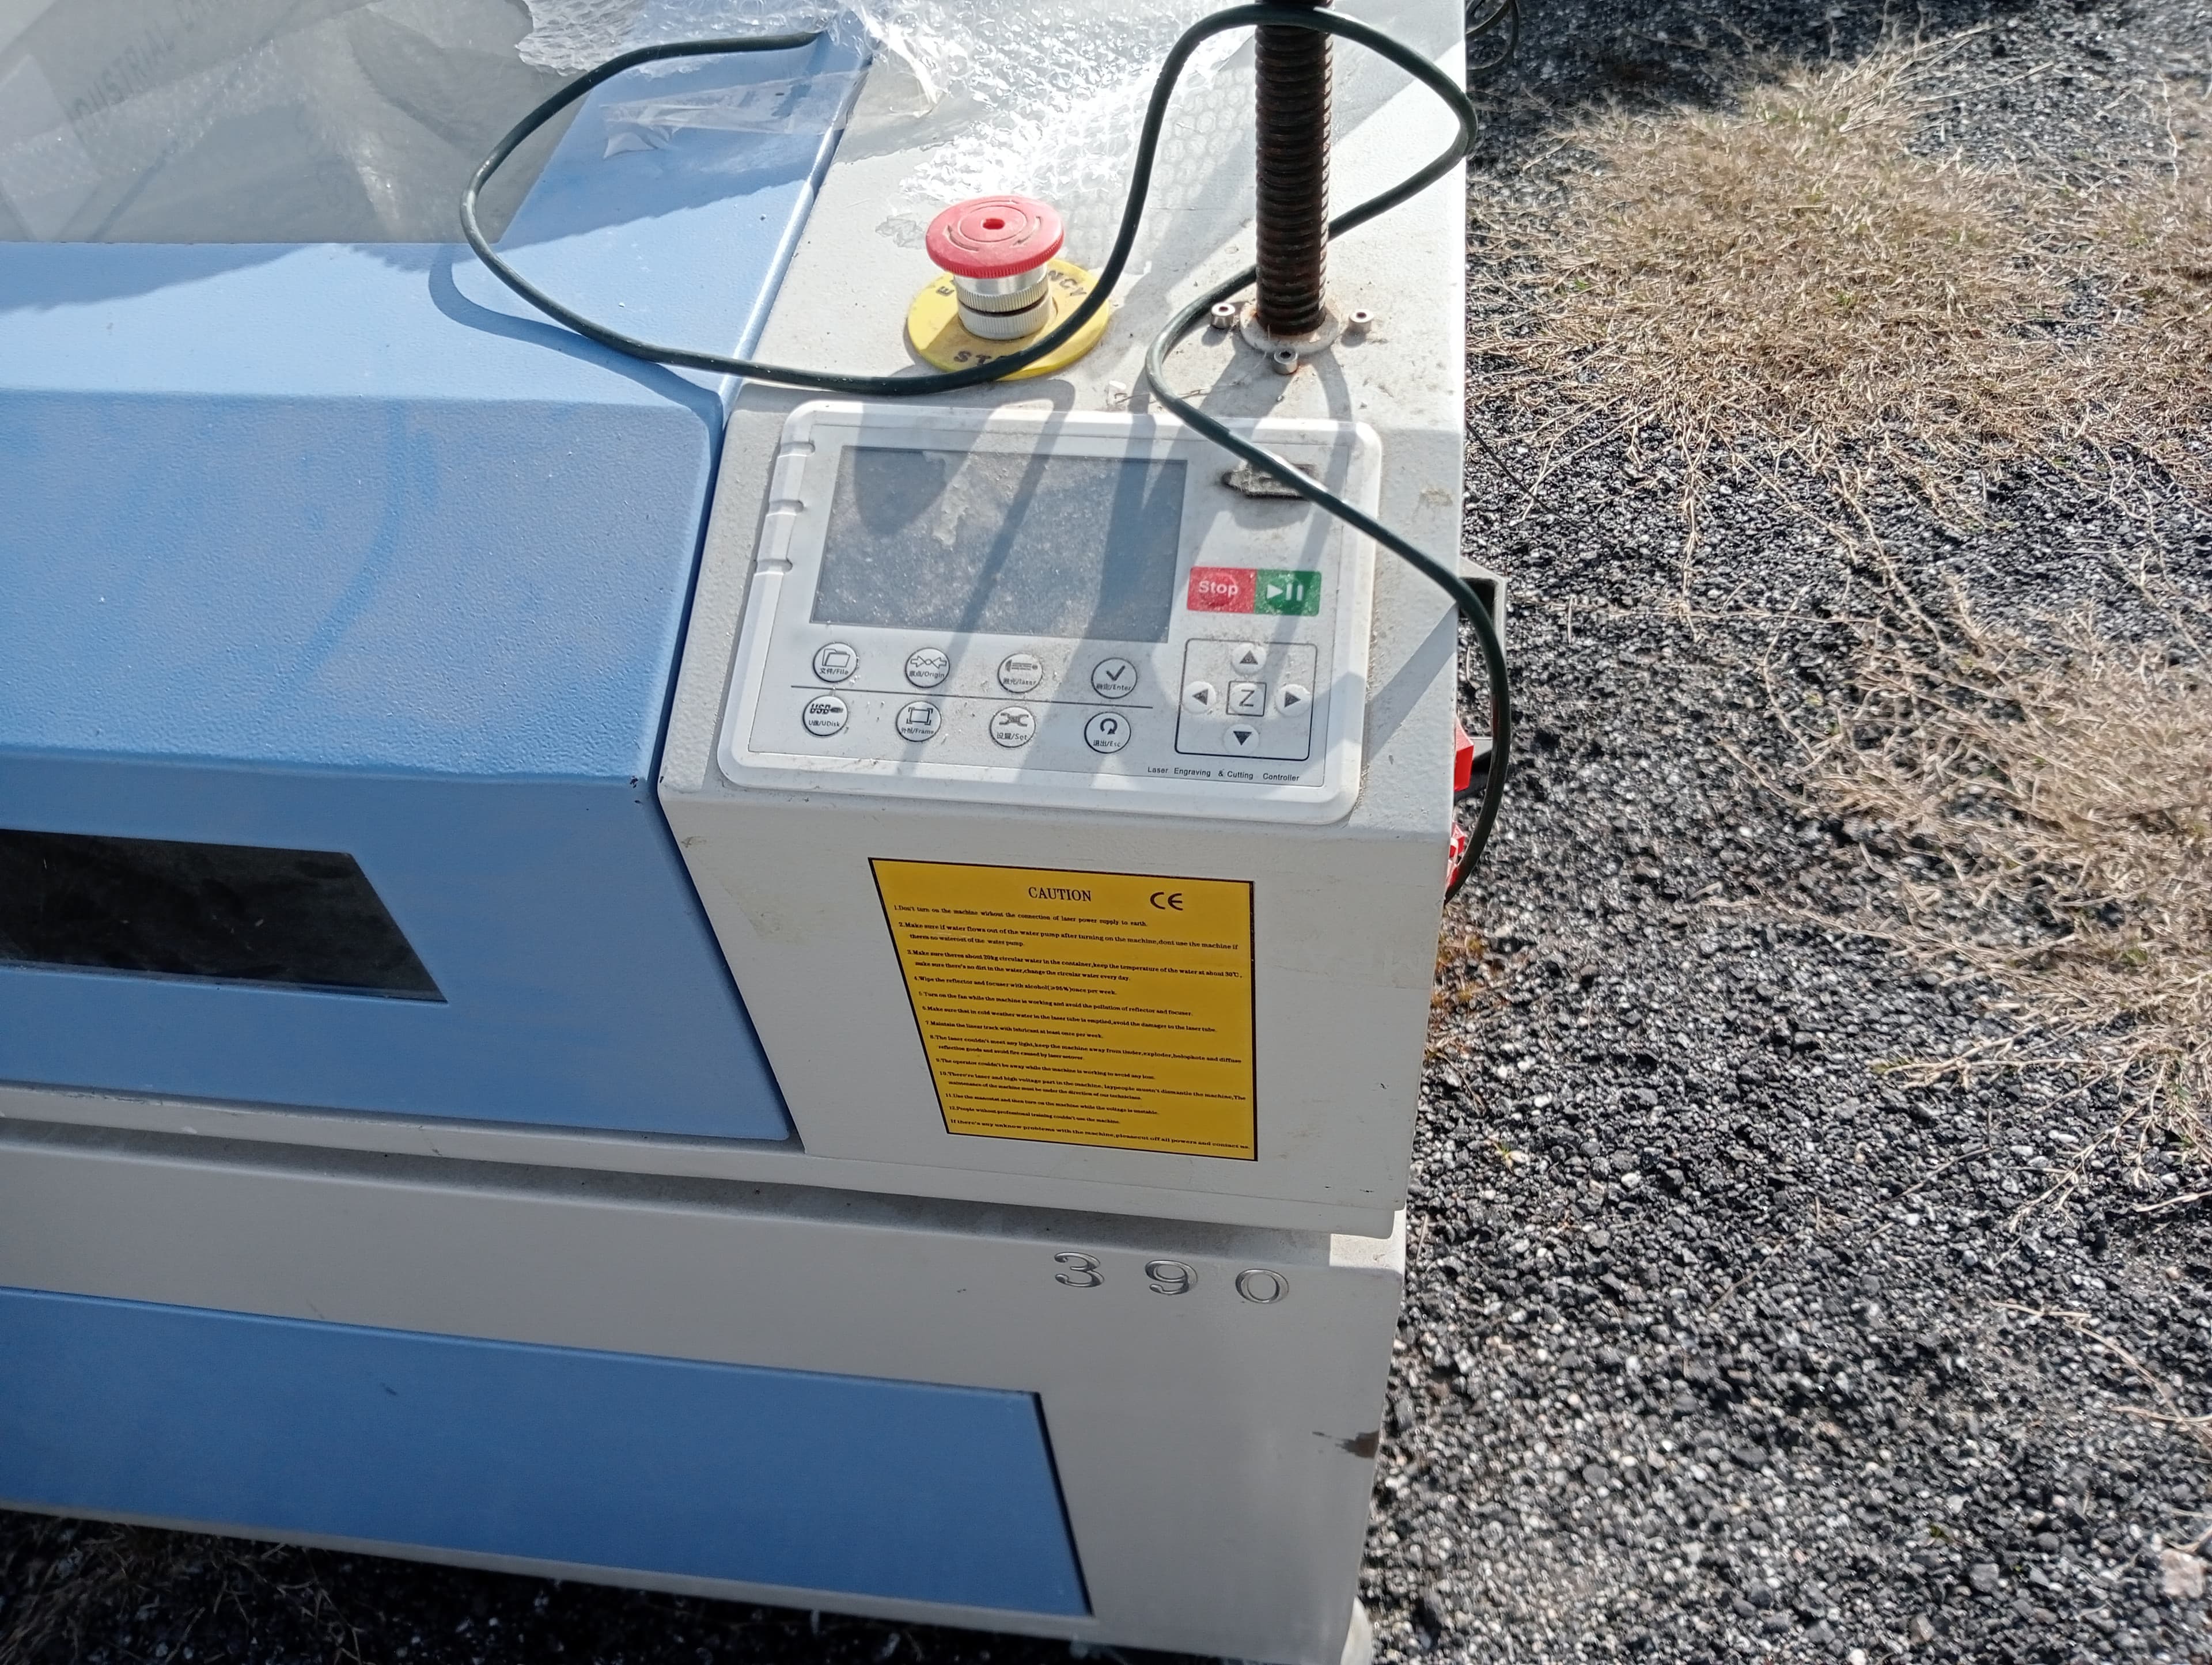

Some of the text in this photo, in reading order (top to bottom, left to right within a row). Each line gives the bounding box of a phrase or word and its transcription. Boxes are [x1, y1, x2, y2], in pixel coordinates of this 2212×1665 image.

[1198, 581, 1238, 596] Stop
[1238, 689, 1255, 707] Z
[1147, 766, 1169, 774] Laser
[1174, 767, 1211, 777] Engraving
[1227, 771, 1253, 780] Cutting
[1263, 772, 1300, 782] Controller
[1028, 887, 1092, 902] CAUTION
[1150, 892, 1183, 911] CE
